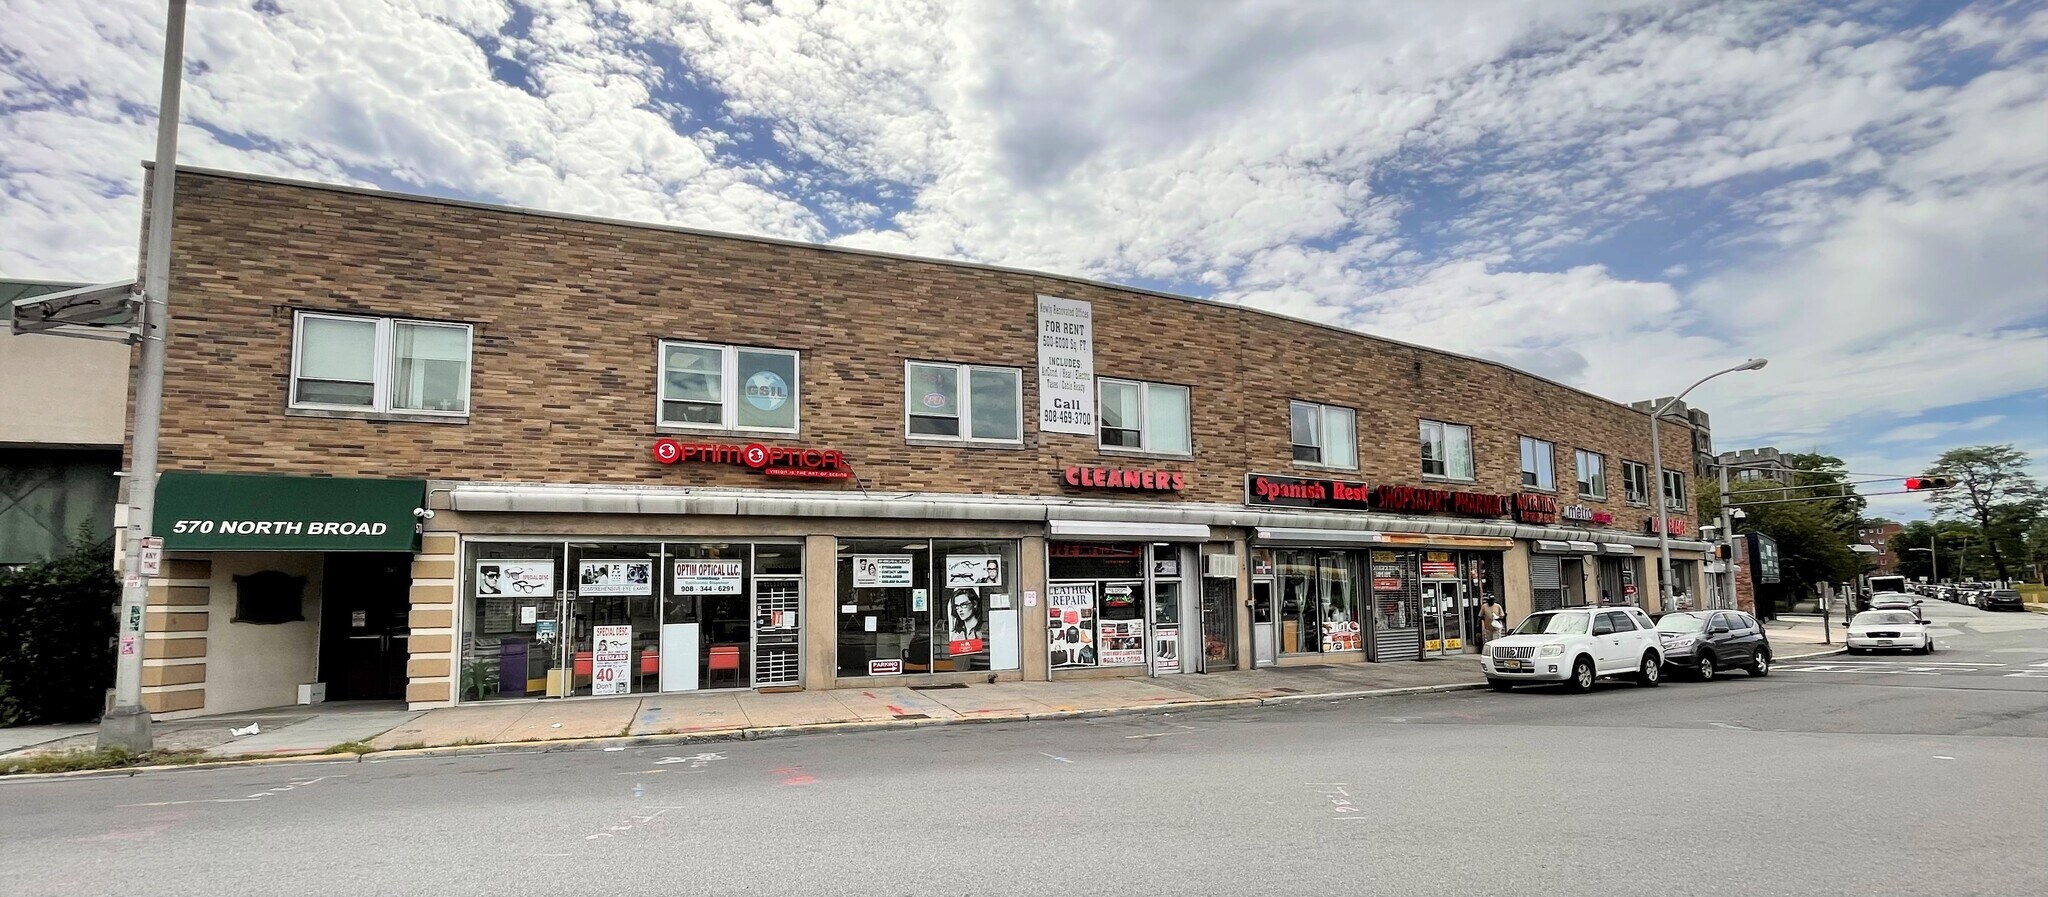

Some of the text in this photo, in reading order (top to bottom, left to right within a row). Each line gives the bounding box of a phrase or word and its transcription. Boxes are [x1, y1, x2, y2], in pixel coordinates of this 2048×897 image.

[1046, 320, 1084, 336] FOR RENT
[1054, 398, 1080, 410] Call
[1044, 409, 1091, 425] 908-469-3700
[1066, 466, 1184, 490] CLEANERS
[1256, 477, 1368, 502] Spanish Rest
[1378, 485, 1448, 512] SHOPSMART
[1516, 493, 1557, 513] NUTRITION
[1568, 504, 1593, 519] metro
[173, 521, 387, 535] 570 NORTH BROAD
[677, 564, 697, 576] OPTIM
[727, 564, 740, 576] LLC.
[1049, 586, 1091, 595] LEATHER
[1053, 595, 1087, 606] REPAIR
[597, 627, 615, 636] SPECIAL
[597, 668, 625, 681] 40 %
